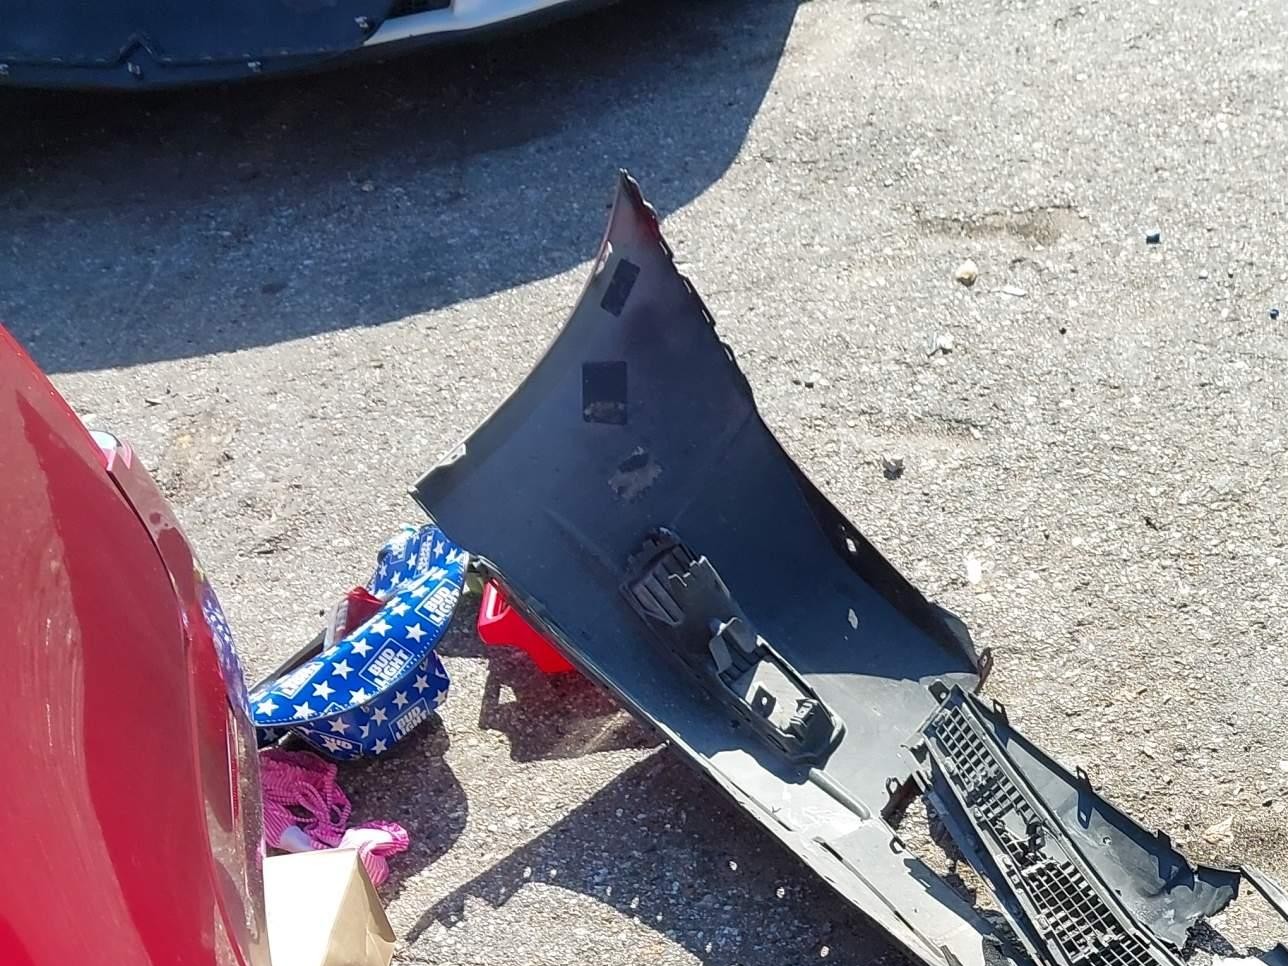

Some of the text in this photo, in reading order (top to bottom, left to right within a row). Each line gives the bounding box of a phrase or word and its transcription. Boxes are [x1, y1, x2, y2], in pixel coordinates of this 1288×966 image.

[423, 586, 451, 612] BUD
[367, 648, 396, 676] BUD
[373, 650, 409, 688] LIGHT
